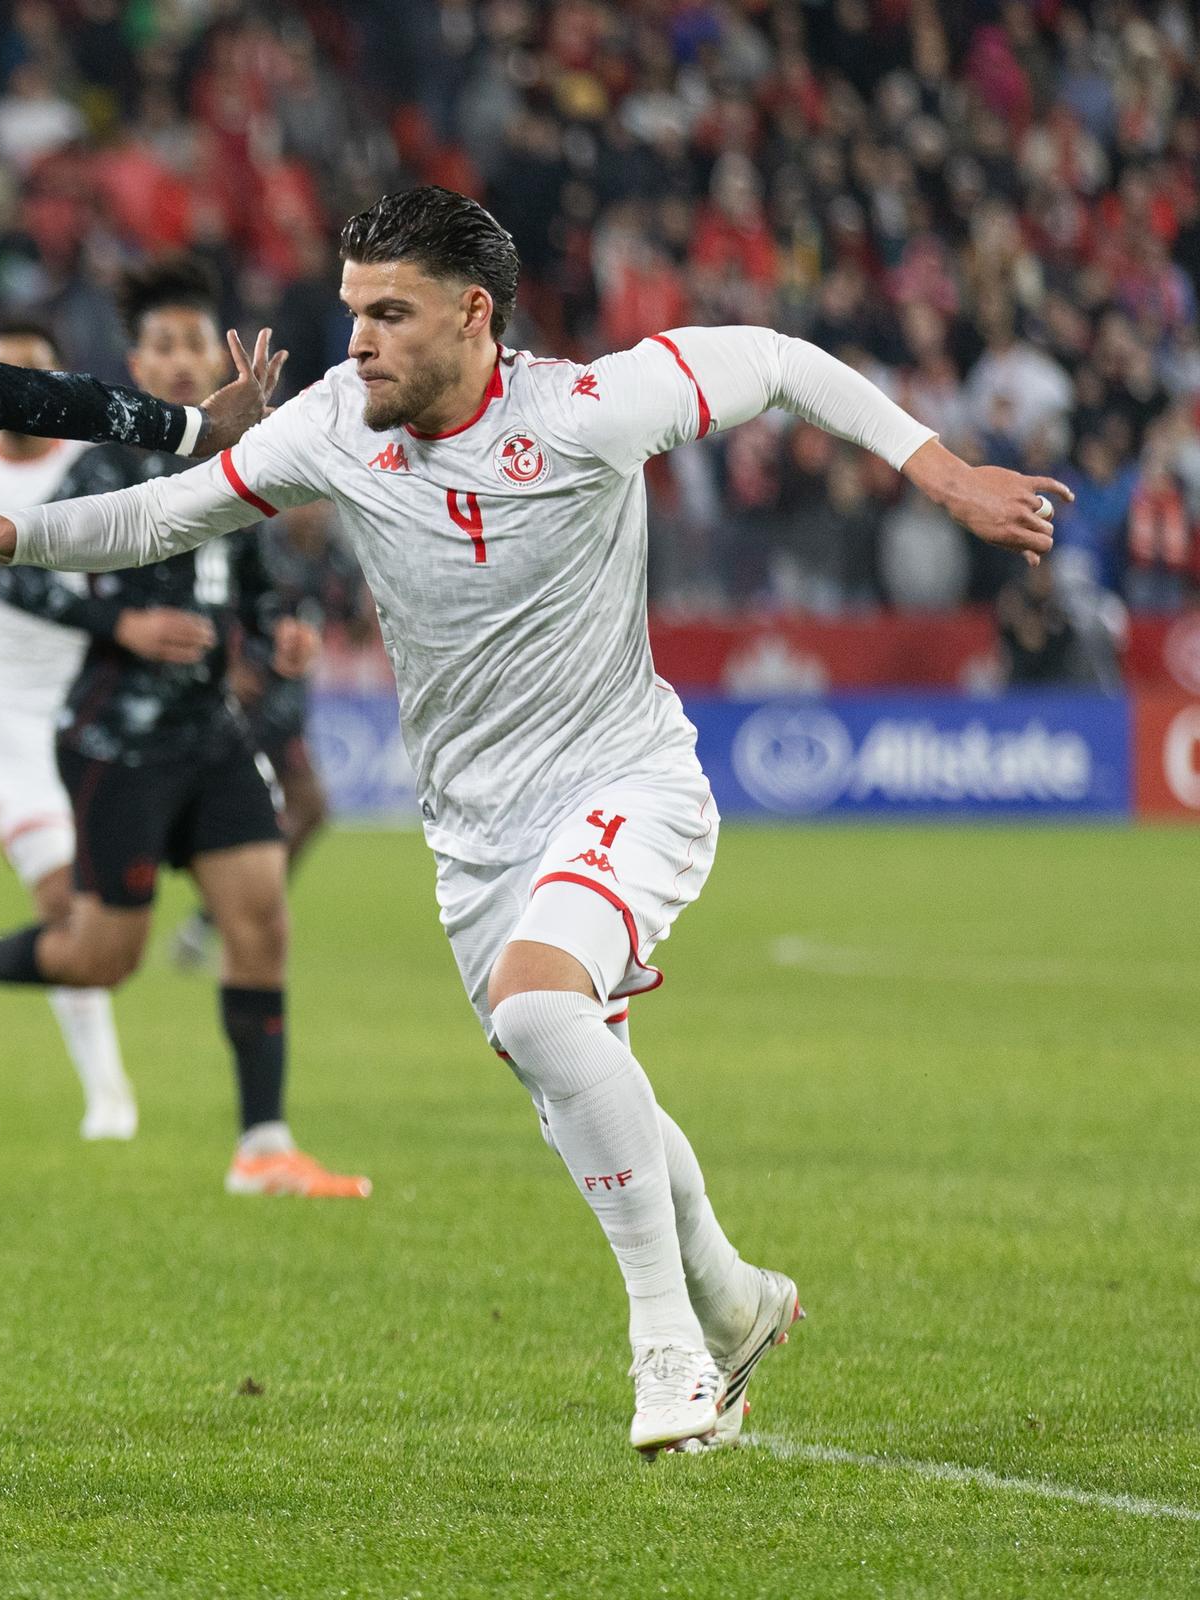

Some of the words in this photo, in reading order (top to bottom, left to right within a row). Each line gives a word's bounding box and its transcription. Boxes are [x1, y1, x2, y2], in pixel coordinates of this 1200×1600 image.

[446, 488, 487, 563] 4
[586, 810, 627, 848] 4
[584, 1168, 632, 1191] FTF
